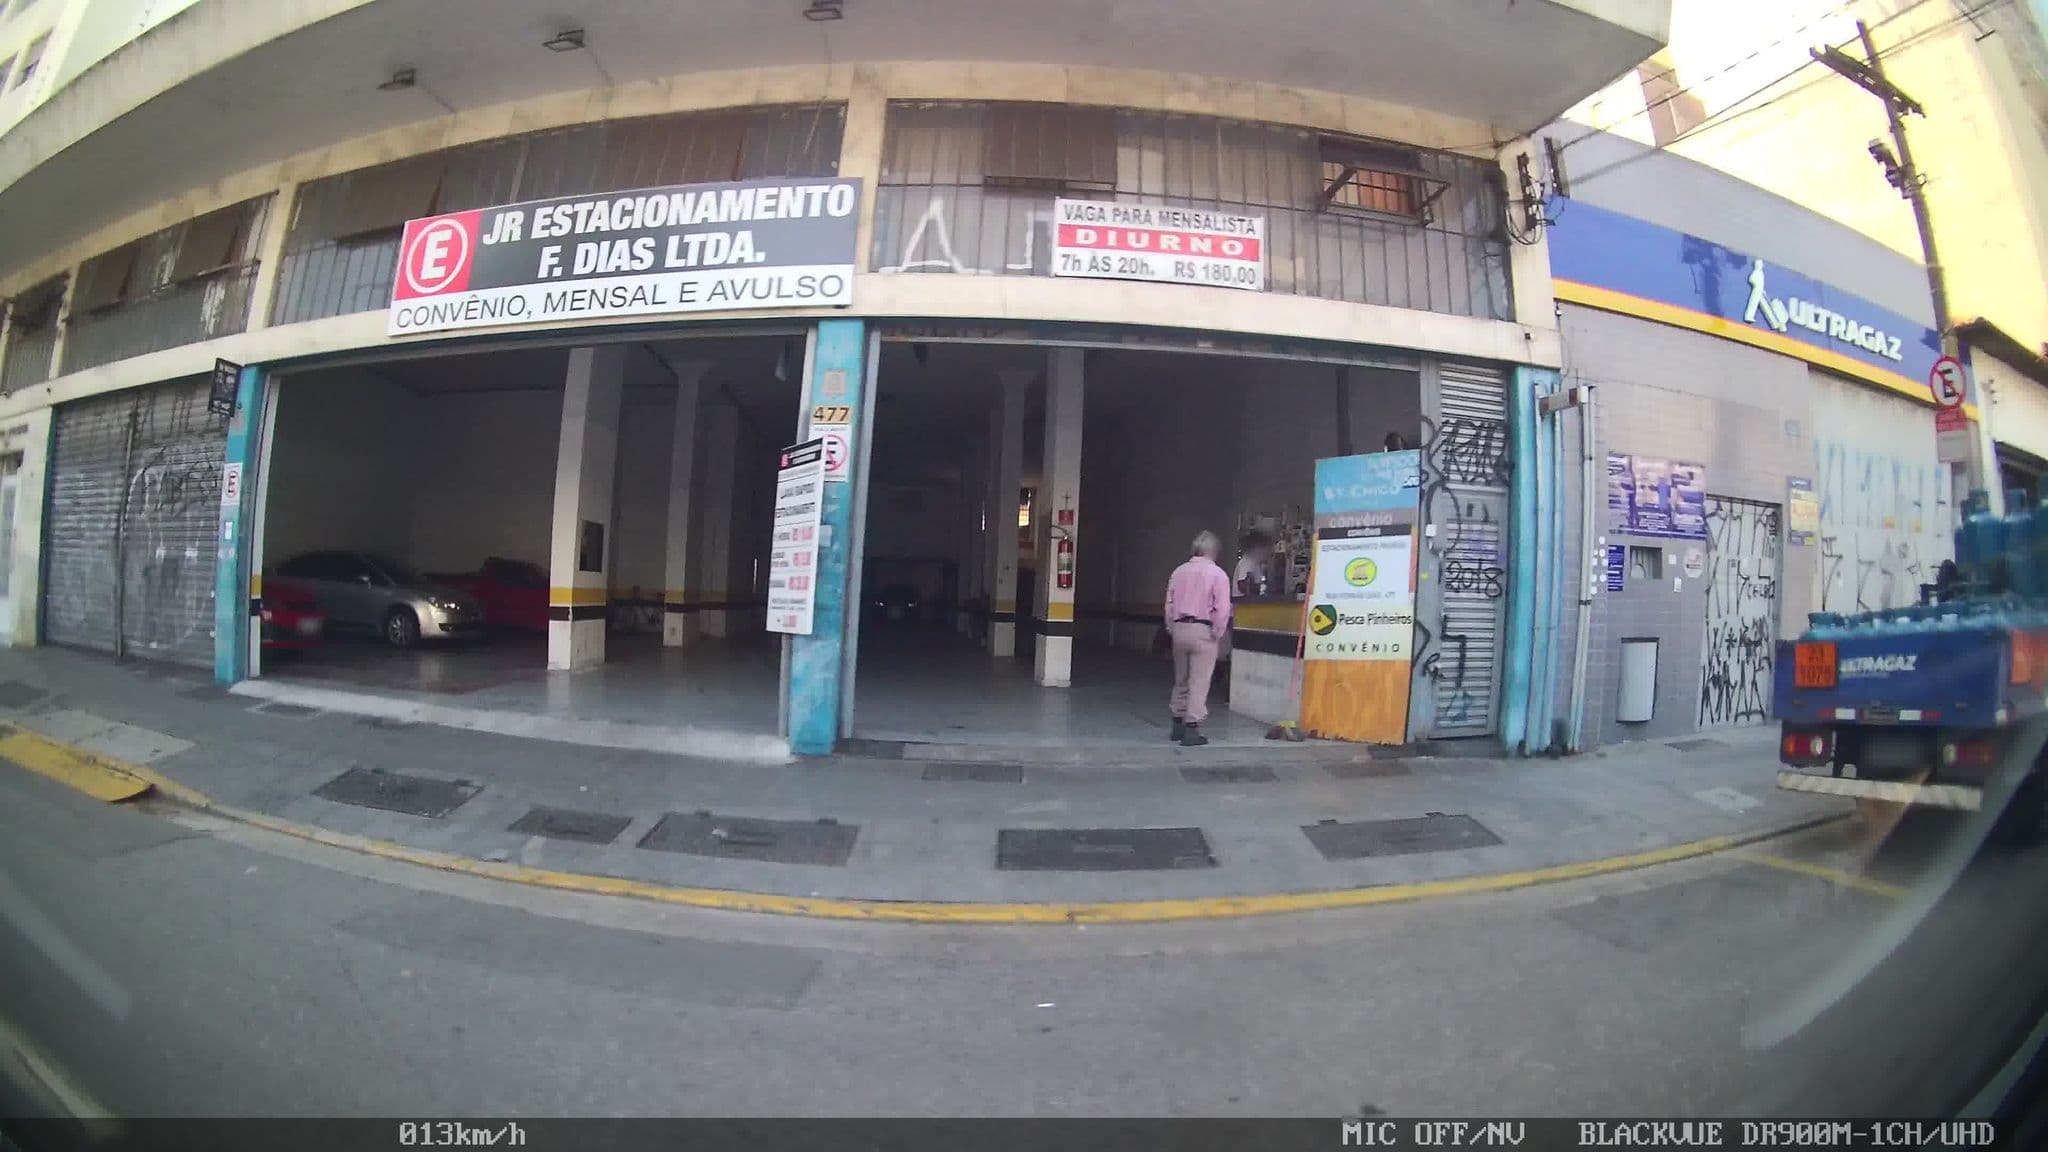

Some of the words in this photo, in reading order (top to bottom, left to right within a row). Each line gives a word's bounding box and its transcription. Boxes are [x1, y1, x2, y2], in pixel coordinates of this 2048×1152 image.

[482, 212, 524, 246] JR
[530, 184, 856, 239] ESTACIONAMENTO
[1063, 204, 1106, 224] VAGA
[1112, 206, 1155, 227] PARA
[1158, 210, 1257, 235] MENSALISTA
[537, 245, 564, 279] F.
[573, 236, 656, 277] DIAS
[664, 230, 767, 269] LTDA.
[1074, 228, 1245, 256] DIURNO
[1061, 253, 1081, 272] 7h
[396, 294, 534, 329] CONVÊNIO,
[542, 281, 667, 315] MENSAL
[679, 281, 699, 303] E
[706, 273, 846, 302] AVULSO
[1787, 297, 1905, 362] ULTRAGAZ
[813, 406, 850, 422] 477
[1339, 613, 1365, 625] Pesca
[1367, 611, 1412, 625] Pinheiros
